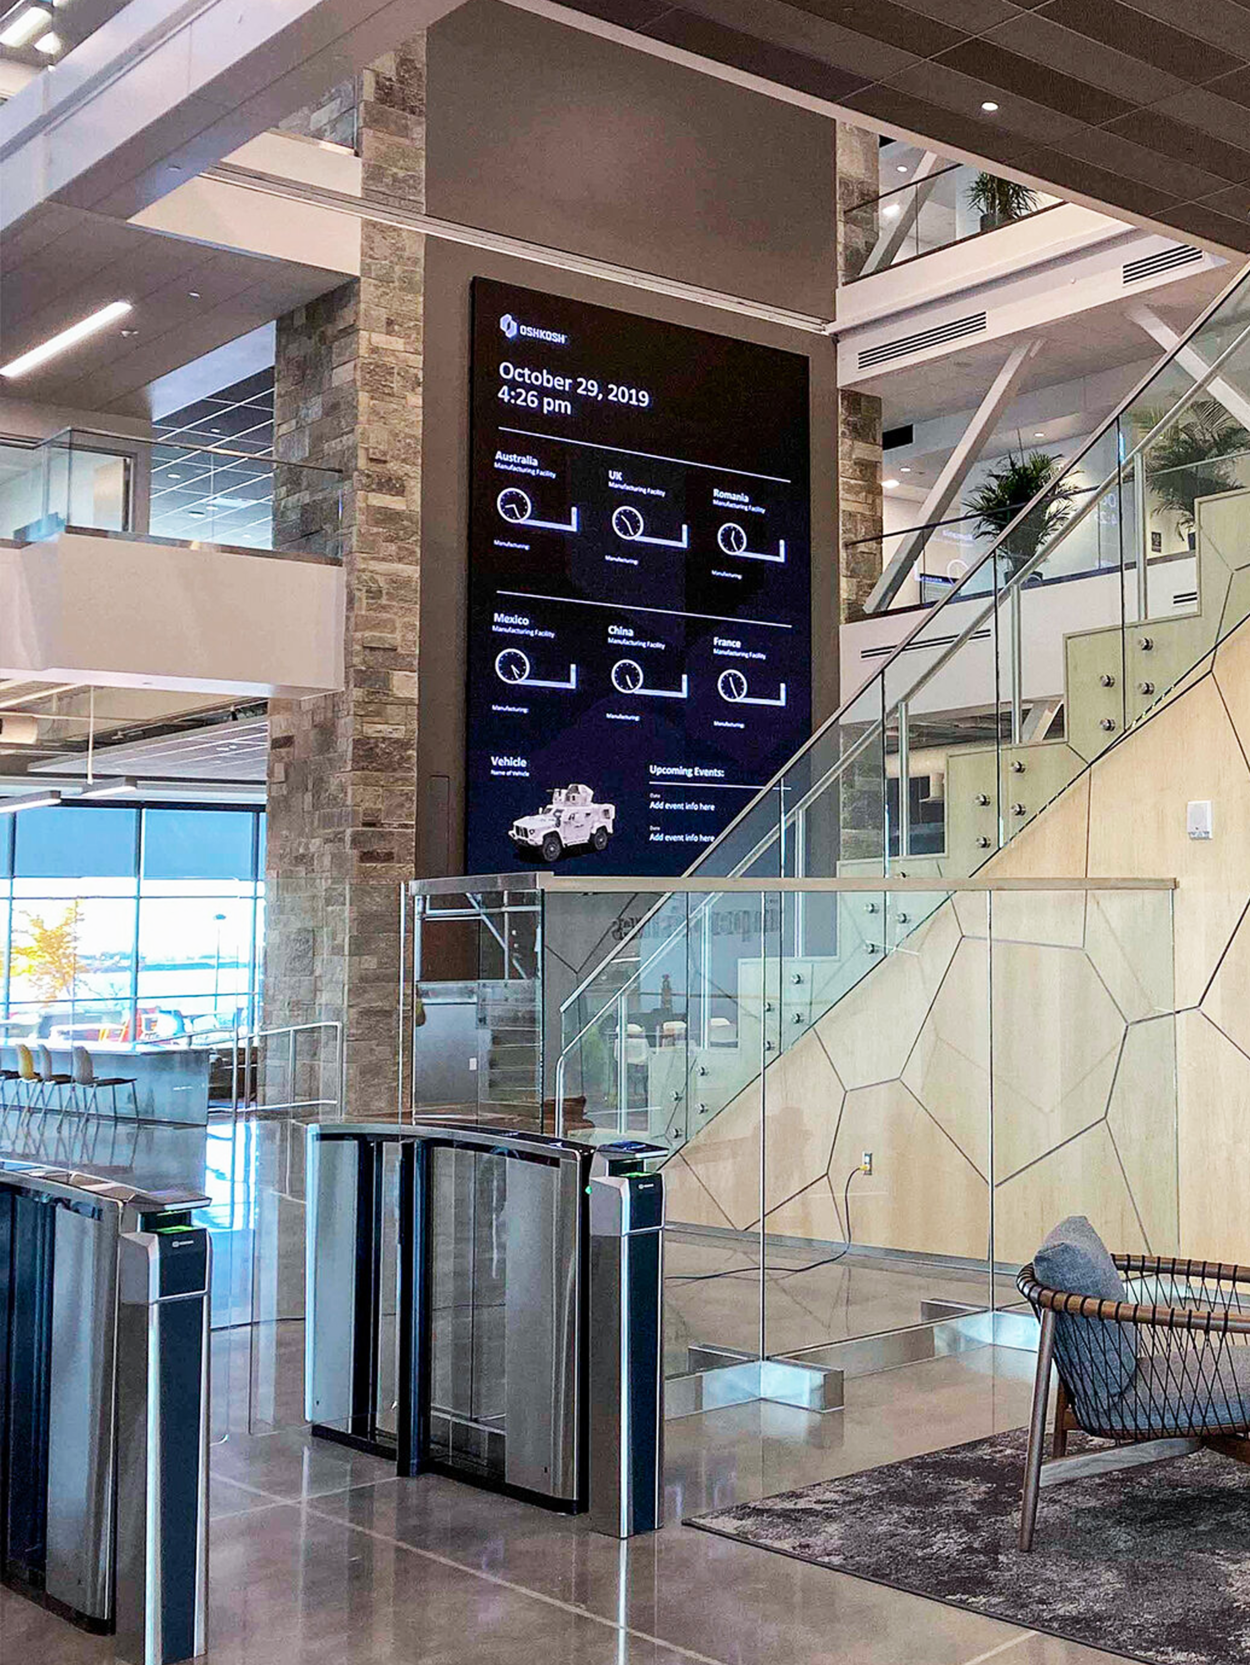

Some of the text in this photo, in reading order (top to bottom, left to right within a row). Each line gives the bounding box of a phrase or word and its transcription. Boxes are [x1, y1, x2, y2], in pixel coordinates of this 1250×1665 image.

[519, 325, 566, 345] OSHKOSH
[499, 361, 650, 408] October 29, 2019
[497, 385, 572, 415] 4:26 pm
[495, 450, 539, 467] Australia
[493, 461, 557, 479] Manufacturing Facility
[608, 469, 623, 481] UK
[608, 481, 666, 498] Manufacturing Facility
[713, 488, 750, 503] Romania
[493, 612, 530, 626] Mexico
[491, 624, 556, 639] Manufacturing Facility
[607, 625, 634, 637] China
[607, 637, 666, 650] Manufacturing Facility
[713, 636, 741, 649] France
[713, 648, 766, 661] Manufacturing Facility
[490, 756, 527, 768] Vehicle
[649, 764, 725, 778] Upcoming Events:
[649, 801, 664, 810] Add
[685, 802, 699, 811] info
[699, 802, 716, 812] here
[649, 833, 716, 843] Add event info here
